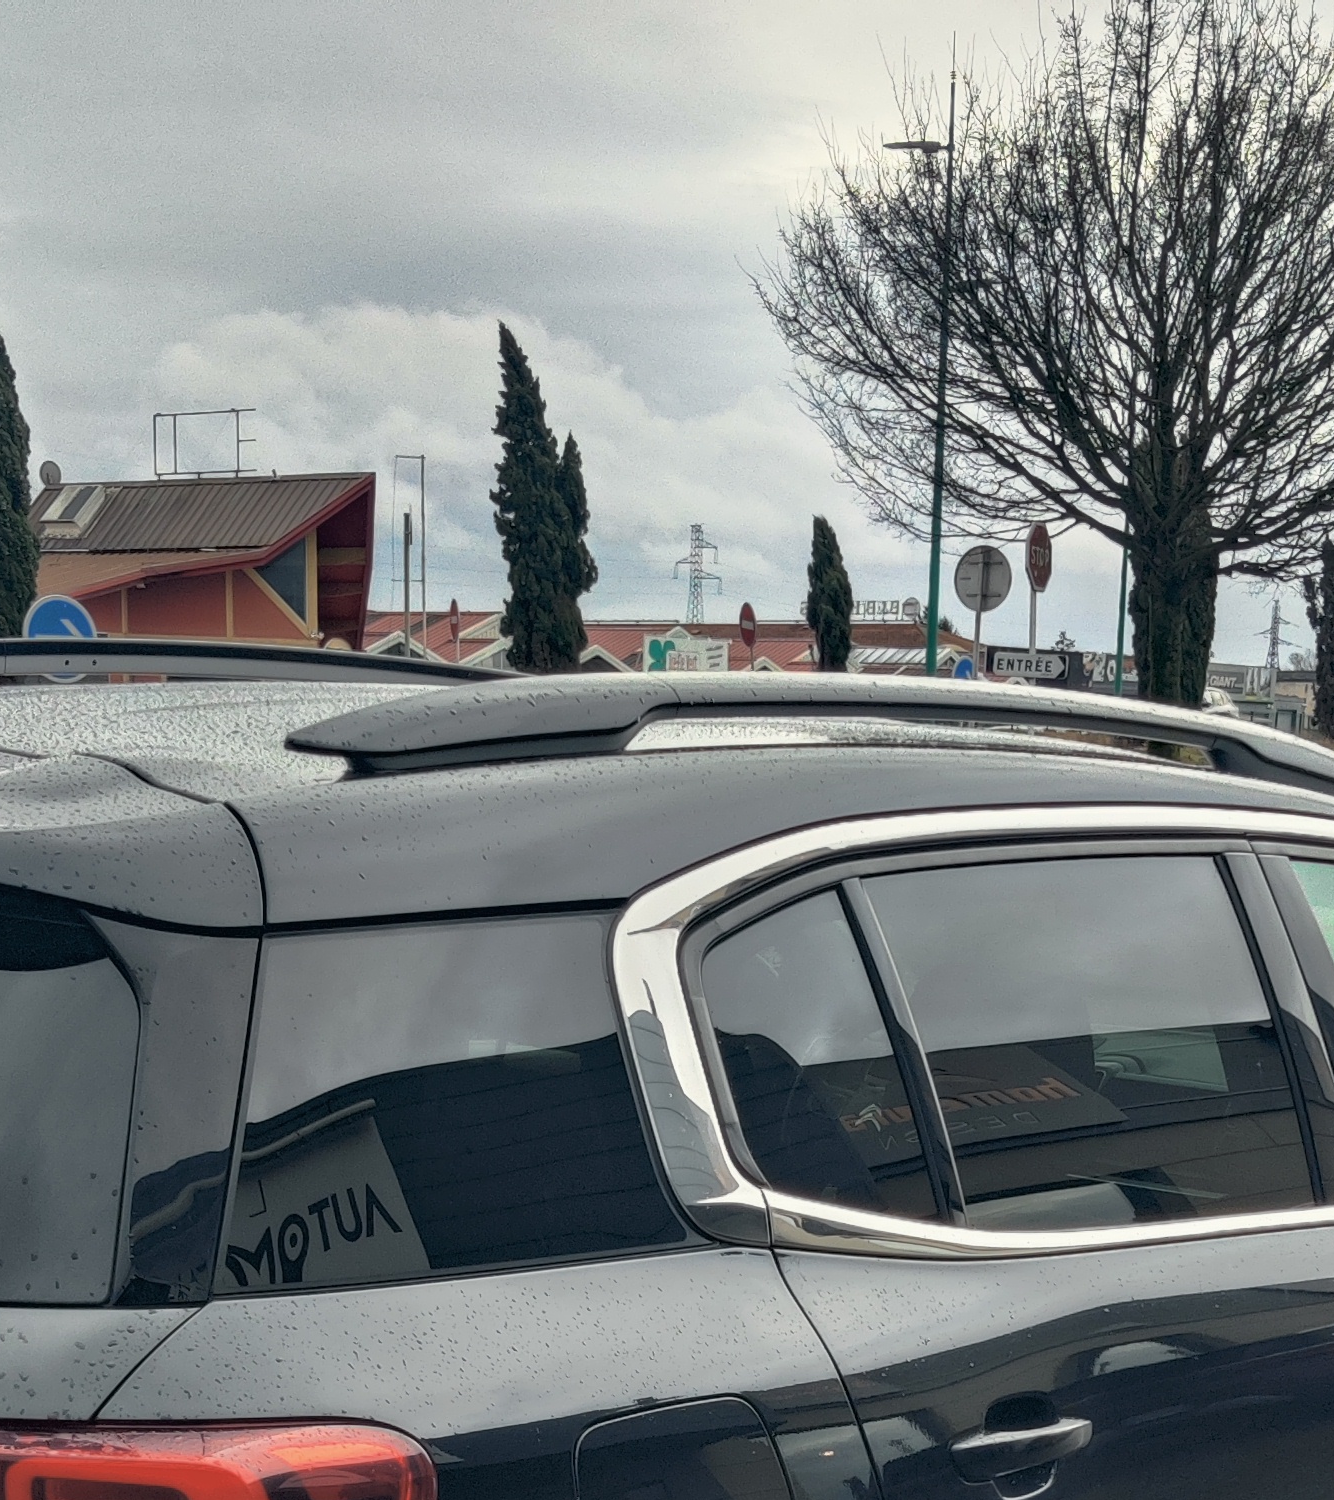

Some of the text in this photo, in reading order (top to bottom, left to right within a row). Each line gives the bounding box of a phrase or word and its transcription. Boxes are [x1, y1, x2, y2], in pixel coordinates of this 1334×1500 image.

[1030, 545, 1051, 567] STOP
[996, 655, 1054, 674] ENTRÉE
[1209, 675, 1238, 688] GIANT
